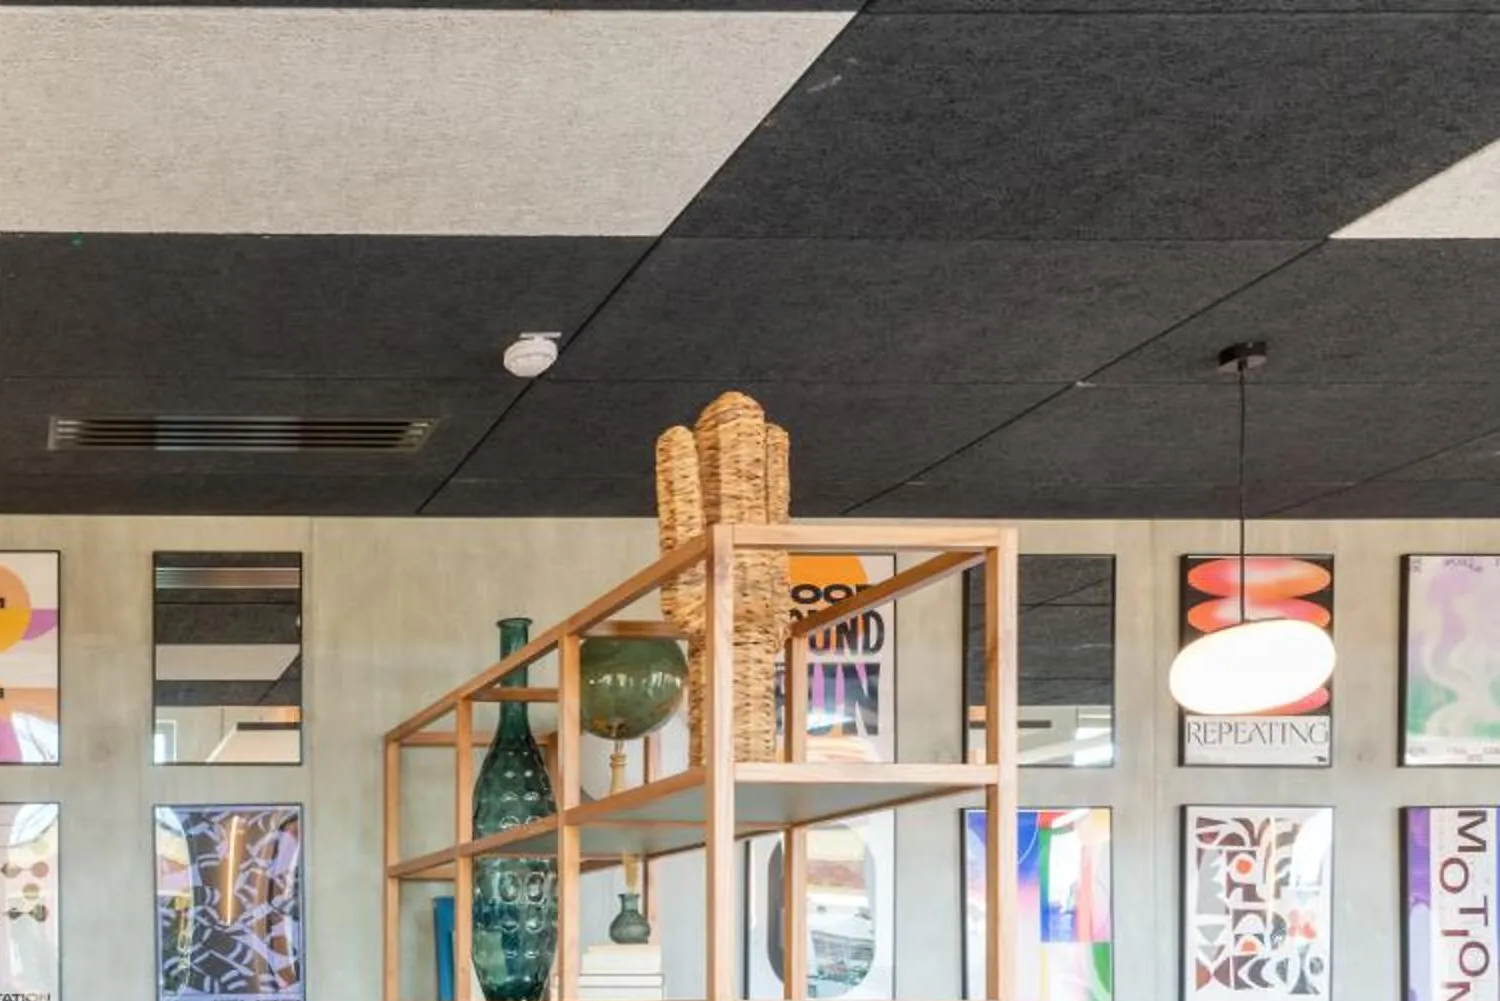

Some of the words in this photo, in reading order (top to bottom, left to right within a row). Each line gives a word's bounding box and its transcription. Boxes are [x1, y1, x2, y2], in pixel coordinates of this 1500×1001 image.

[791, 583, 876, 605] OO
[789, 608, 885, 656] UND
[1186, 721, 1330, 746] REPEATING
